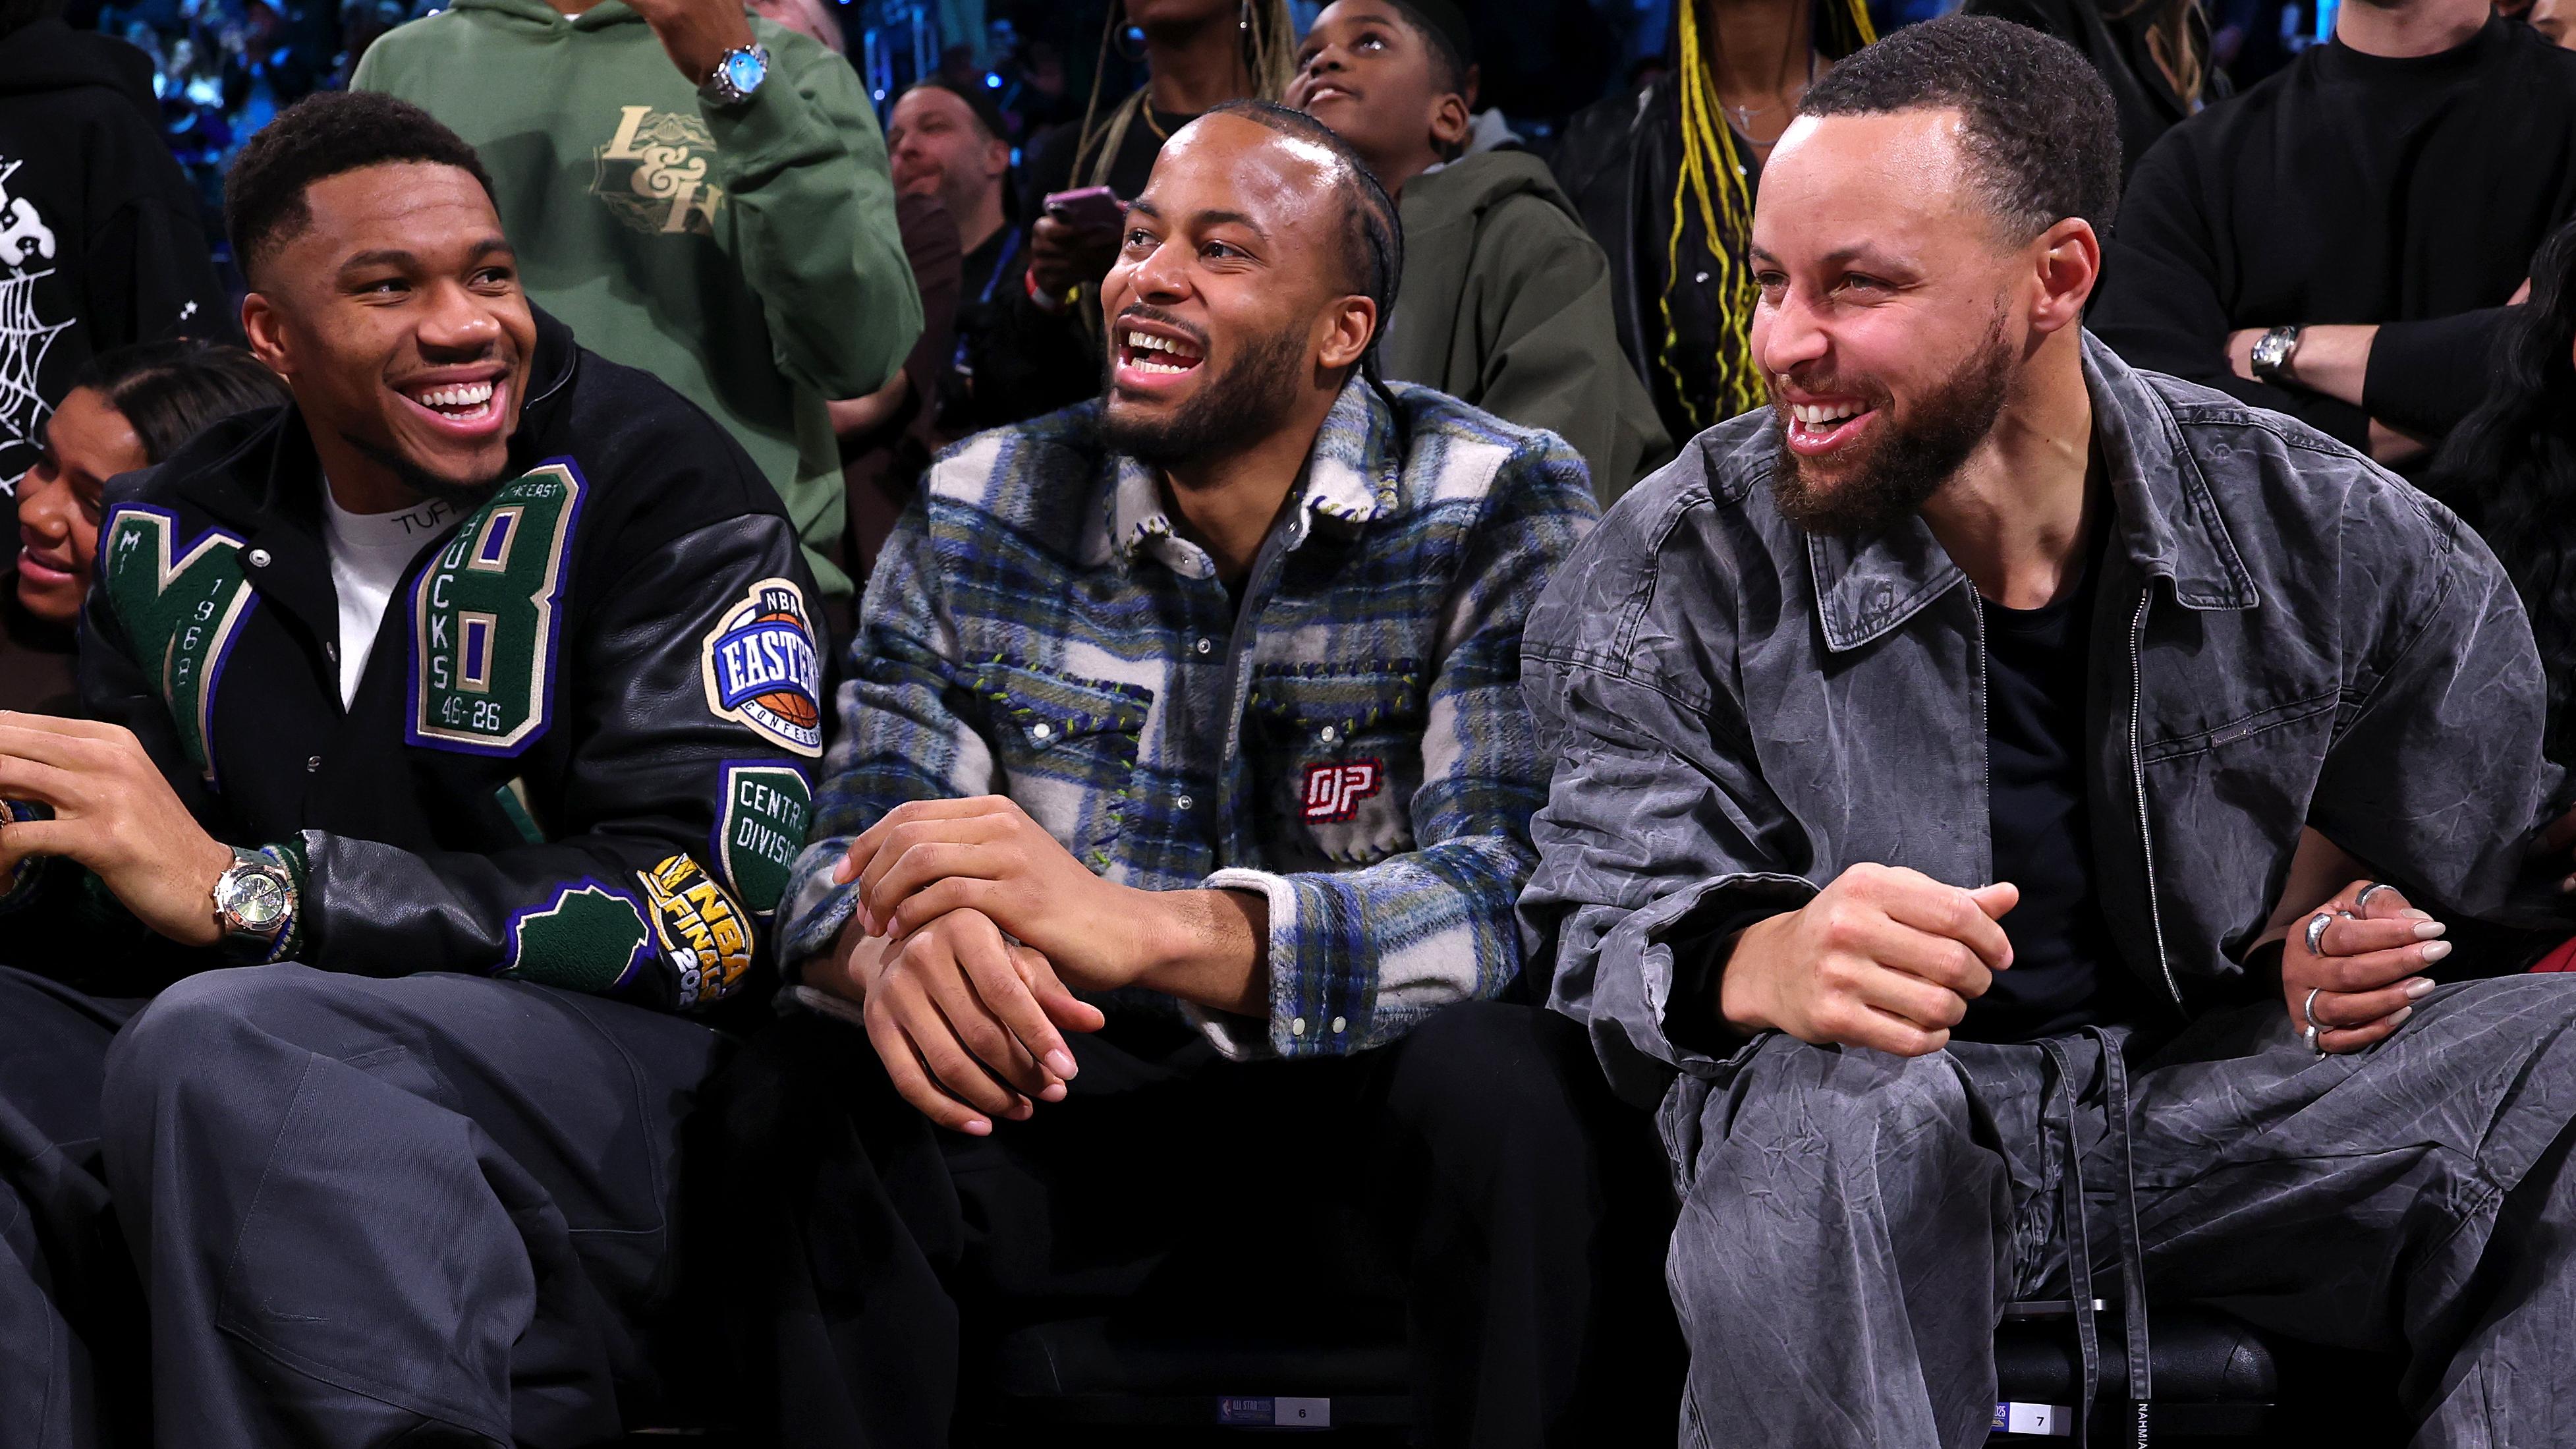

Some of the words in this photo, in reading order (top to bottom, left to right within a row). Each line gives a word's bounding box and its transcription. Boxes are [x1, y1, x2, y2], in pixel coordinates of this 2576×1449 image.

[766, 591, 799, 617] NBA
[441, 695, 501, 731] 46-26
[682, 880, 751, 986] NBA
[1298, 1409, 1306, 1418] 6
[2036, 1416, 2045, 1427] 7
